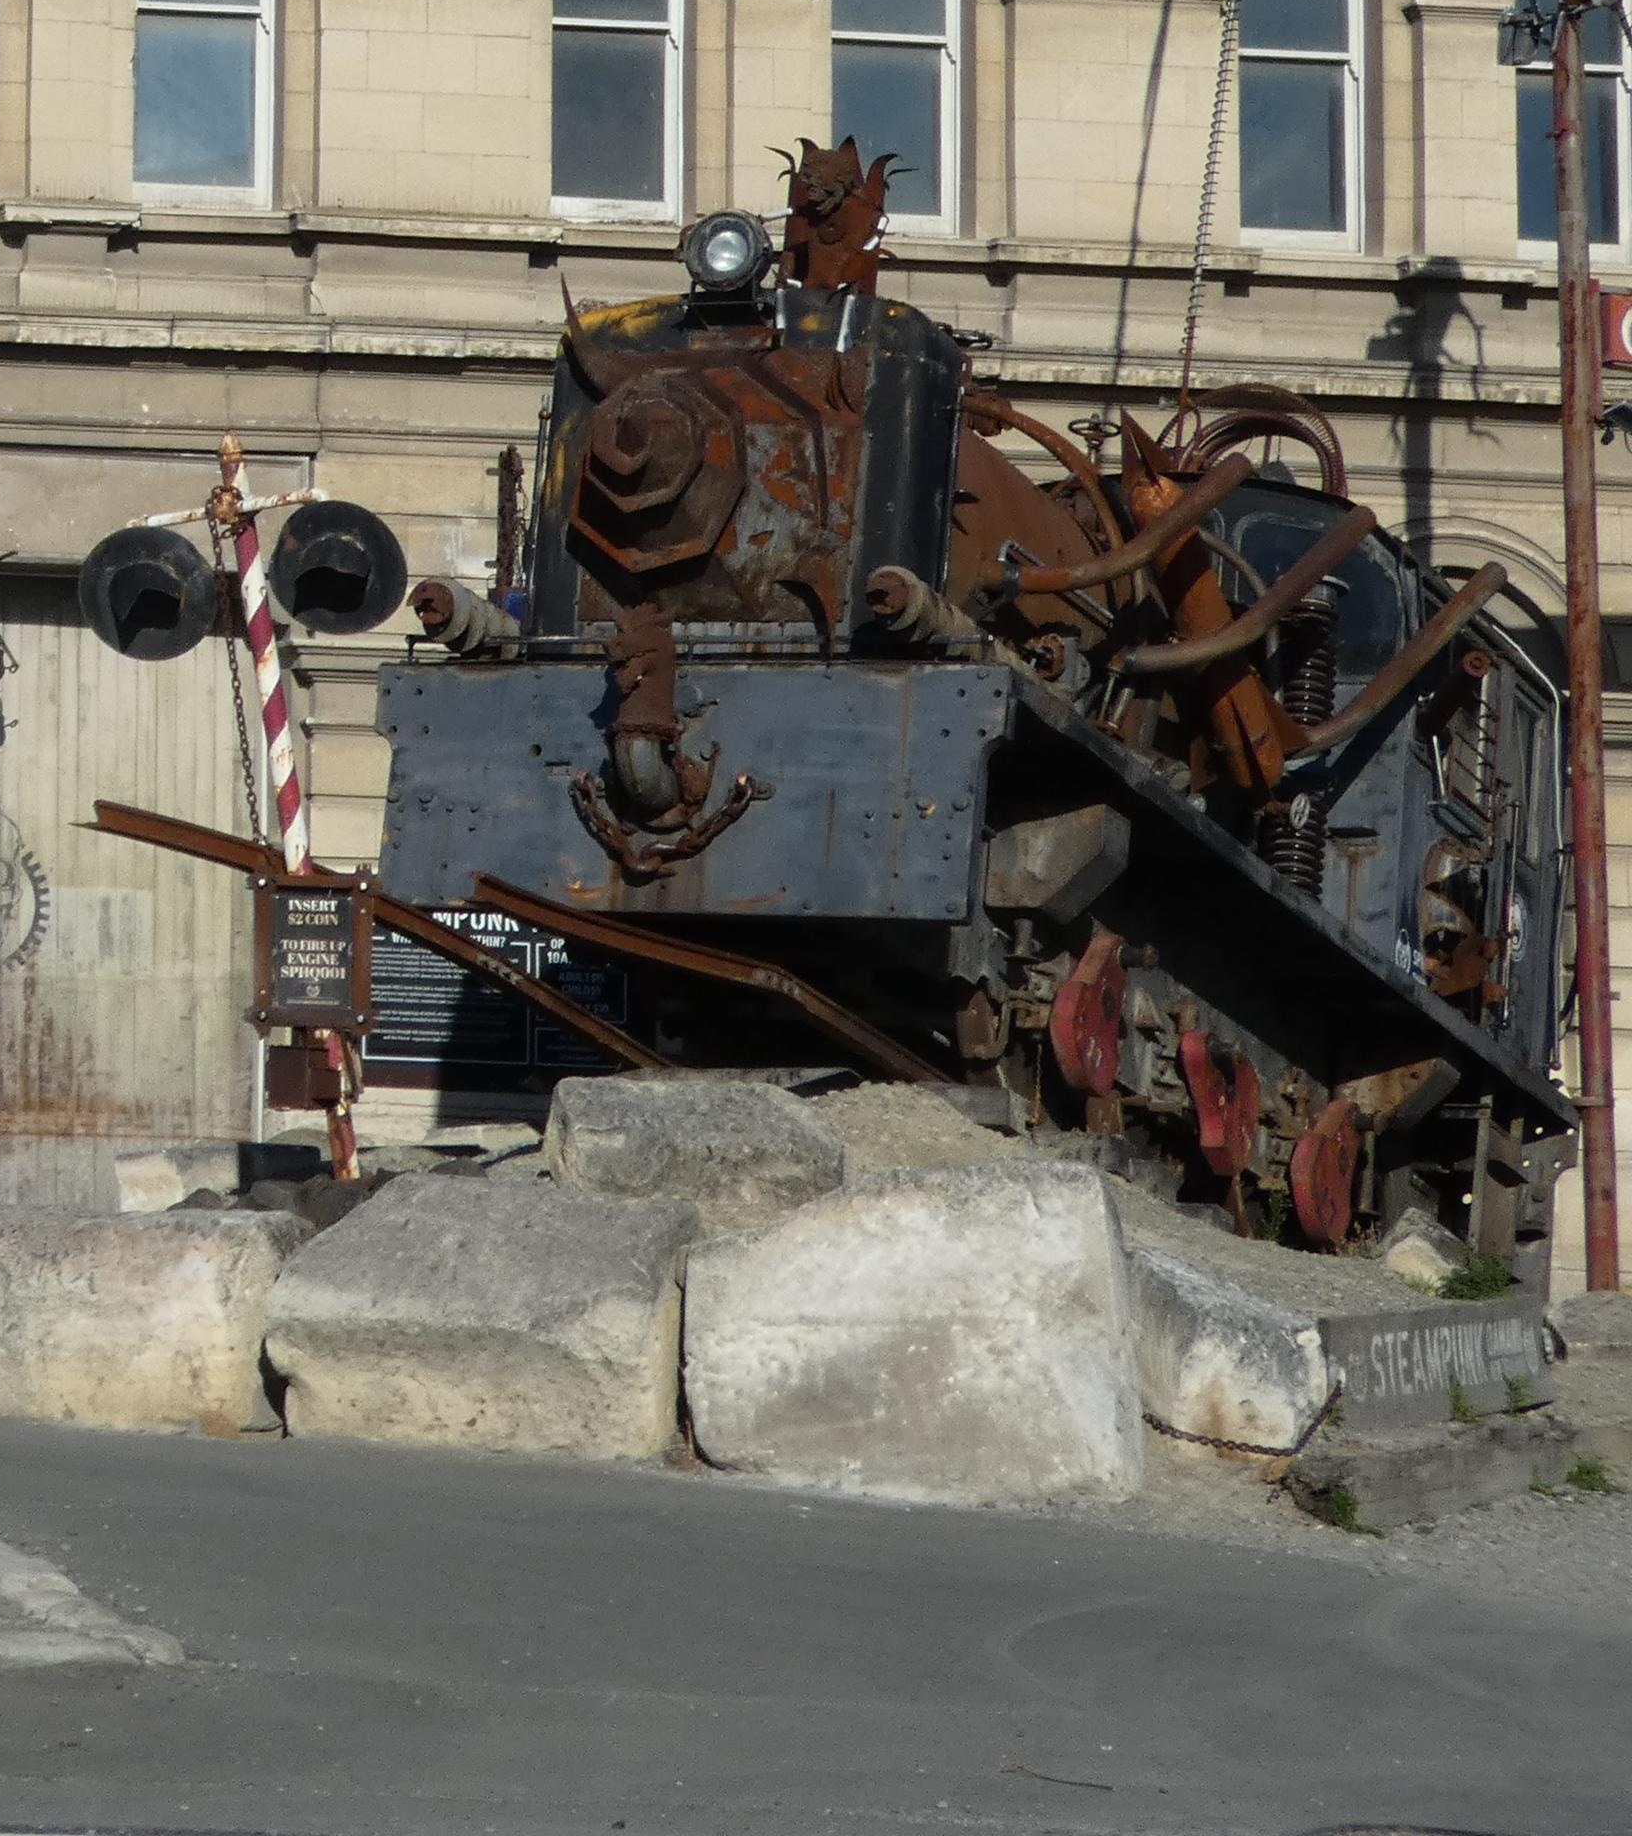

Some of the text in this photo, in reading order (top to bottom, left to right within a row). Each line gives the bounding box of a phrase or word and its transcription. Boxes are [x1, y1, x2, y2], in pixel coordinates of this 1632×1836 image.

[288, 899, 338, 912] INSERT
[288, 913, 338, 926] $2 COIN
[280, 939, 347, 952] TO FIRE UP
[287, 952, 339, 965] ENGINE
[1371, 1322, 1487, 1397] STEAMPUNK
